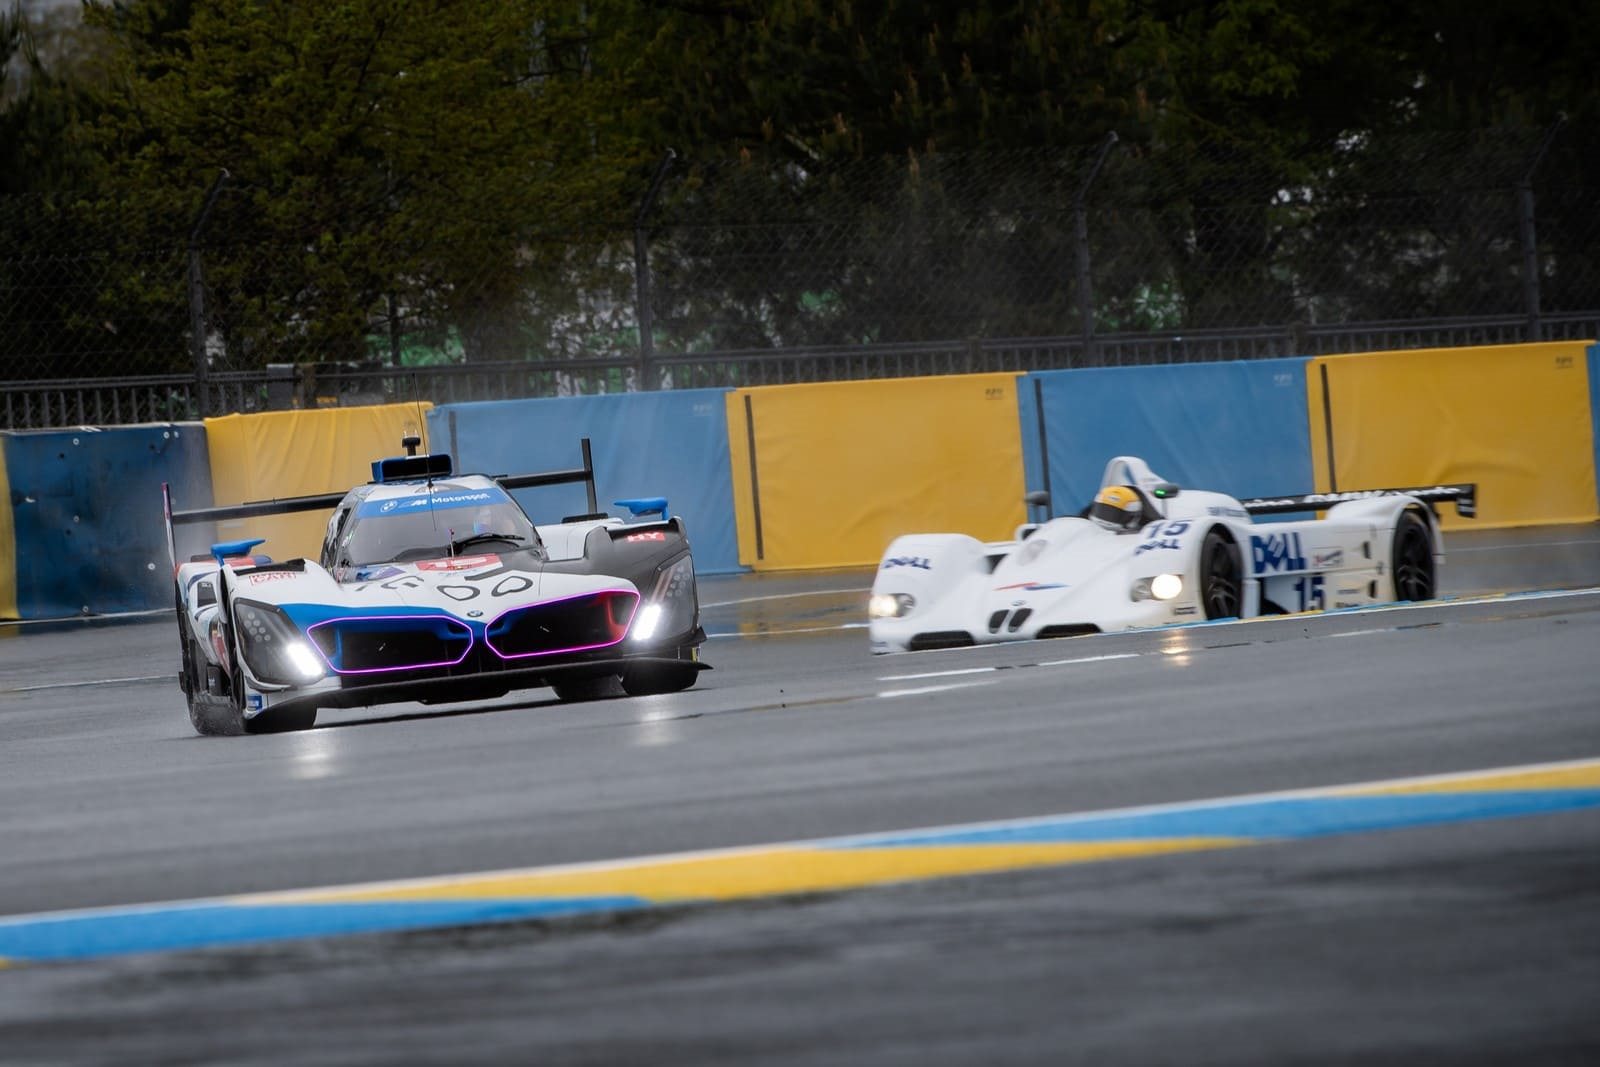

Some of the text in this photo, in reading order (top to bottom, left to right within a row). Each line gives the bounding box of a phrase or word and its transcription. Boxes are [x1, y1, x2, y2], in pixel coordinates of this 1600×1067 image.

[1146, 519, 1191, 539] 15
[1249, 531, 1307, 574] DELL
[1294, 575, 1327, 614] 15
